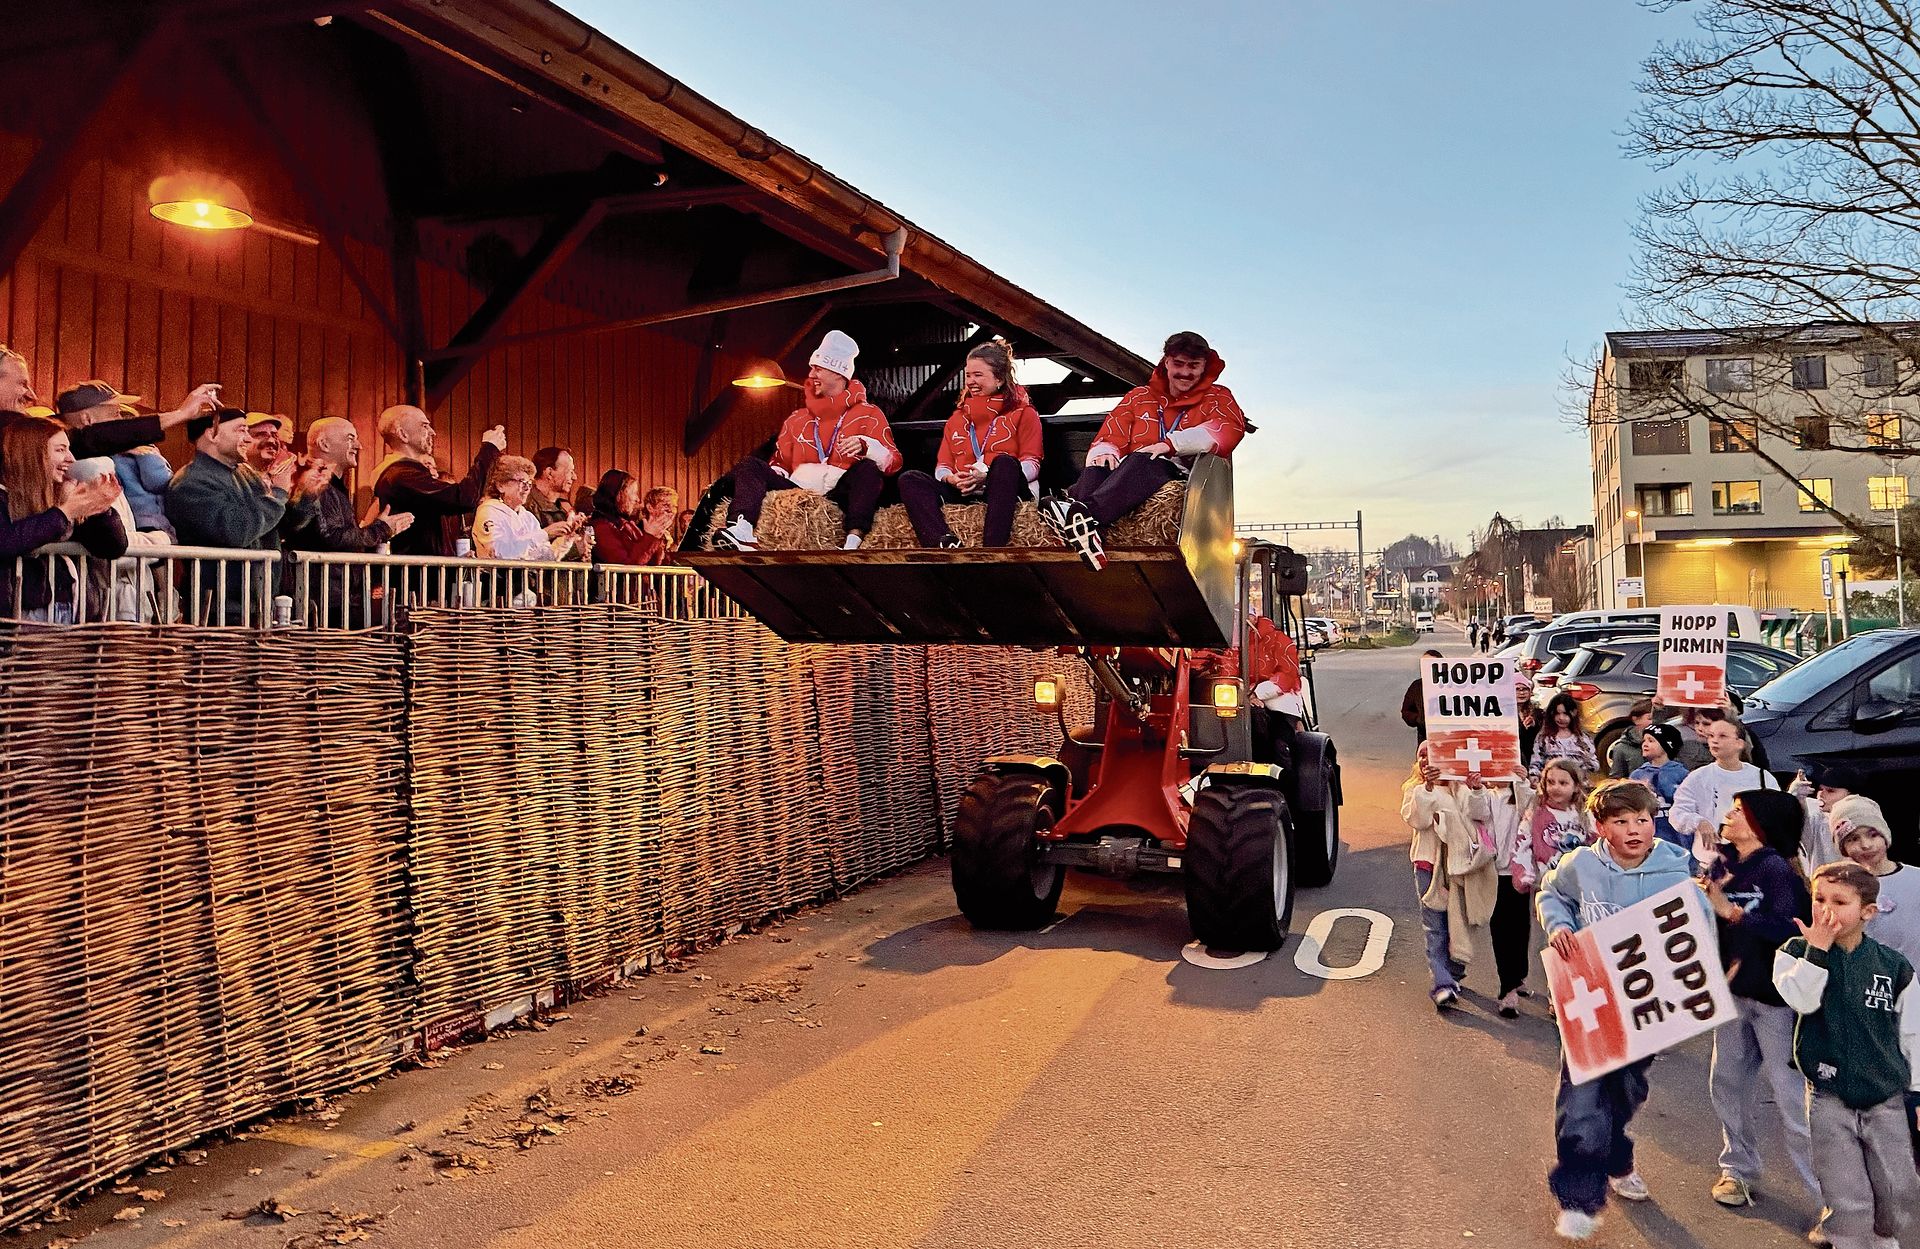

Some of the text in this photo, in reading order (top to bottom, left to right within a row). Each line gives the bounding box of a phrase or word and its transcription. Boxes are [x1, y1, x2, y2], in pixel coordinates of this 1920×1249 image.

[1671, 615, 1717, 630] HOPP
[1662, 637, 1724, 653] PIRMIN
[1431, 662, 1504, 684] HOPP
[1438, 695, 1503, 717] LINA
[1652, 896, 1715, 1021] HOPP
[1611, 933, 1676, 1031] NOÉ
